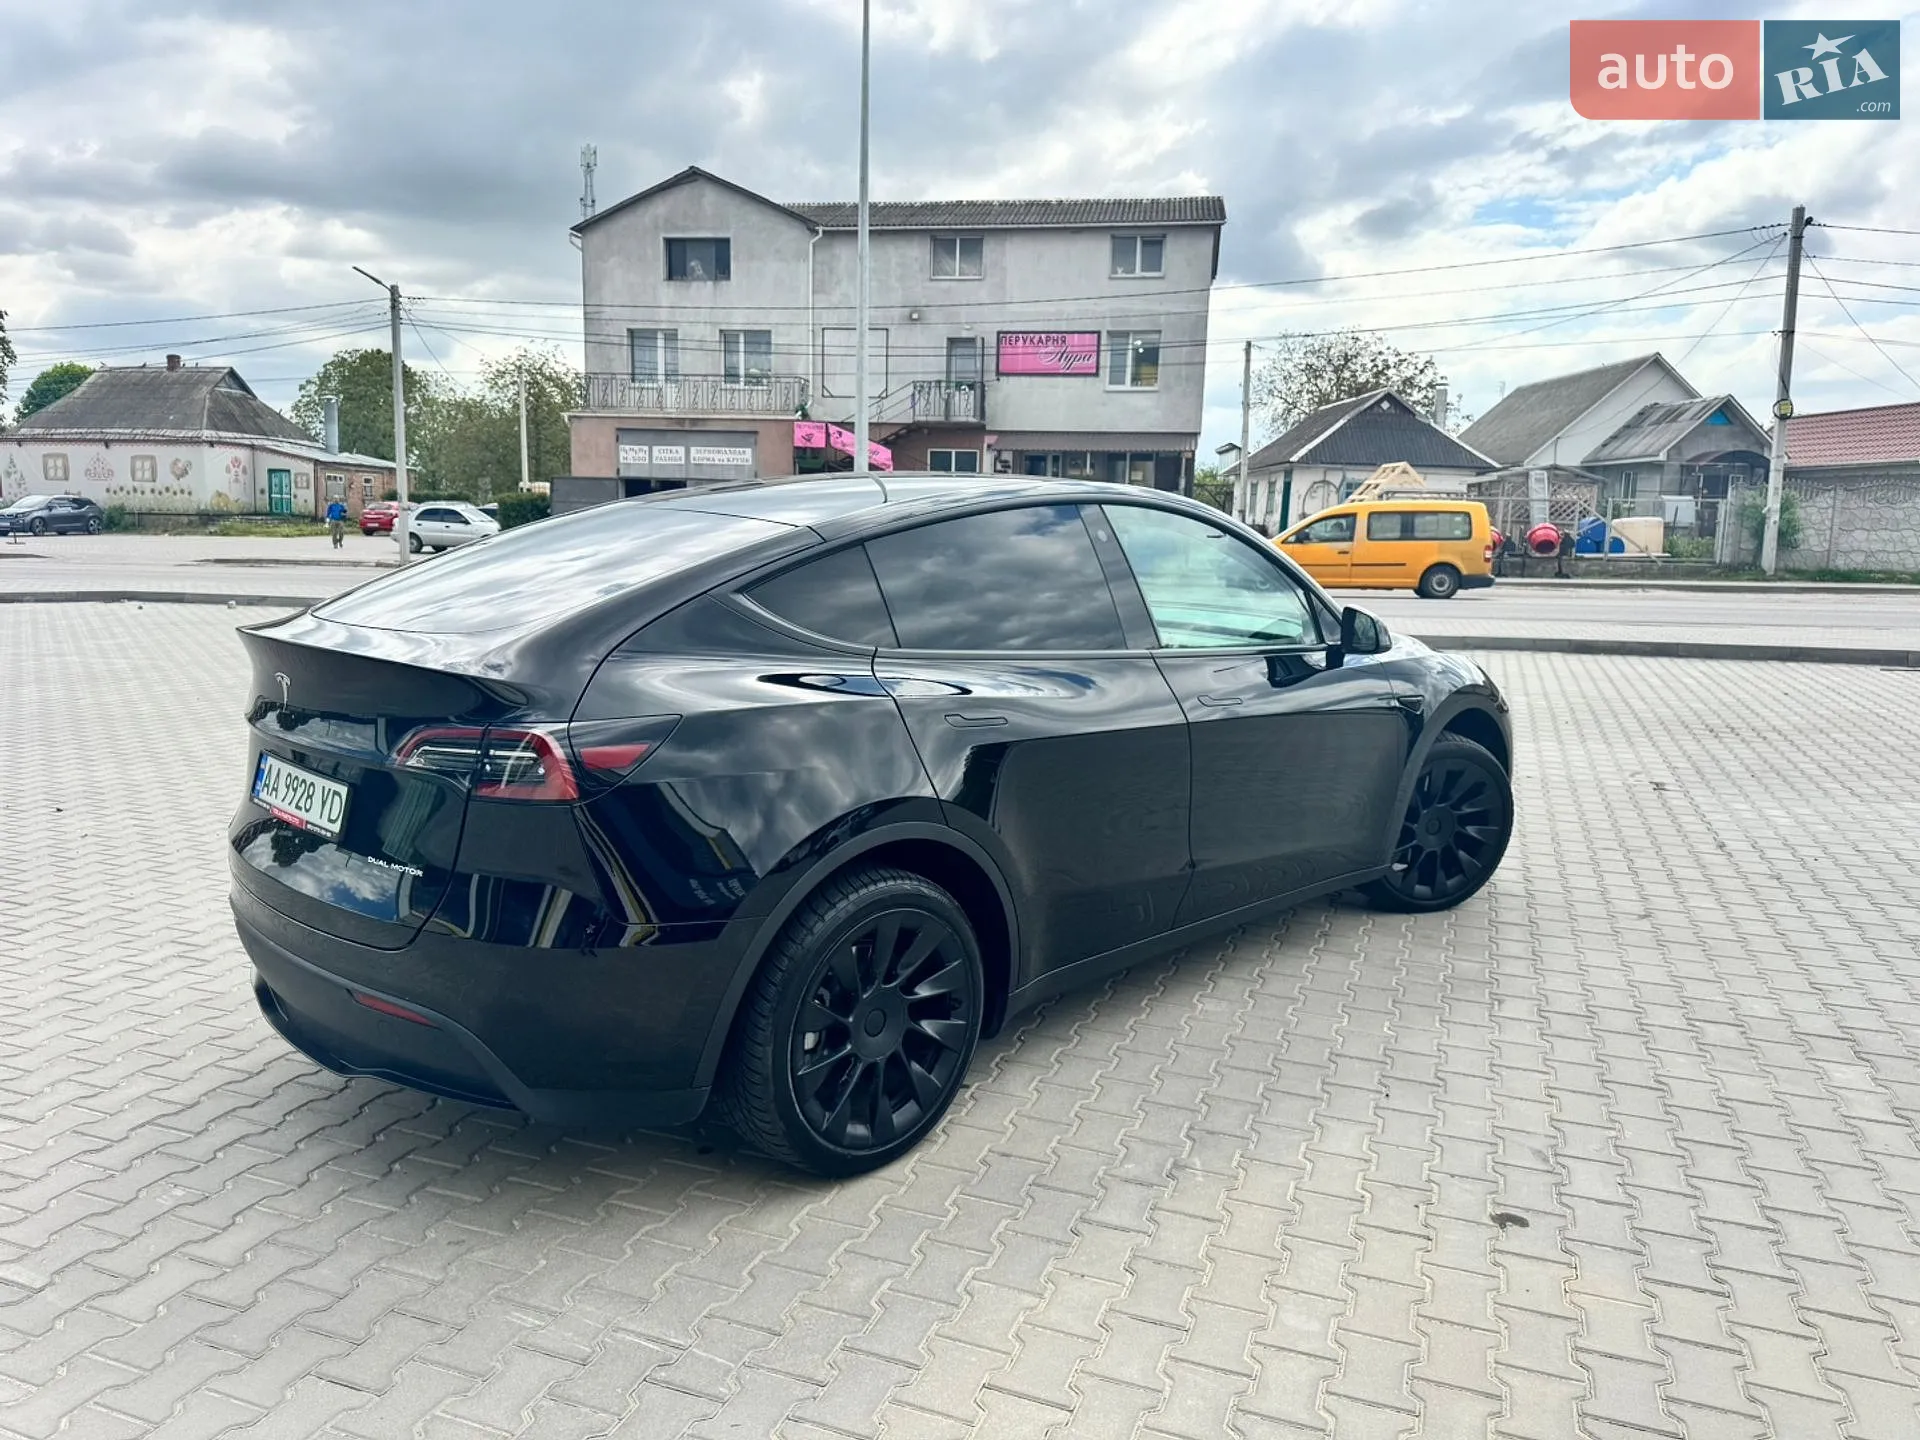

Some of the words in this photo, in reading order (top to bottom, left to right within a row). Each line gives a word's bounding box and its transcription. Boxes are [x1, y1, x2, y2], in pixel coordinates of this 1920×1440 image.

[1001, 335, 1067, 346] ПЕРУКАРНЯ
[262, 764, 280, 799] AA
[281, 772, 315, 812] 9928
[320, 786, 343, 823] YD
[367, 856, 389, 867] DUAL
[390, 862, 423, 877] MOTOR
